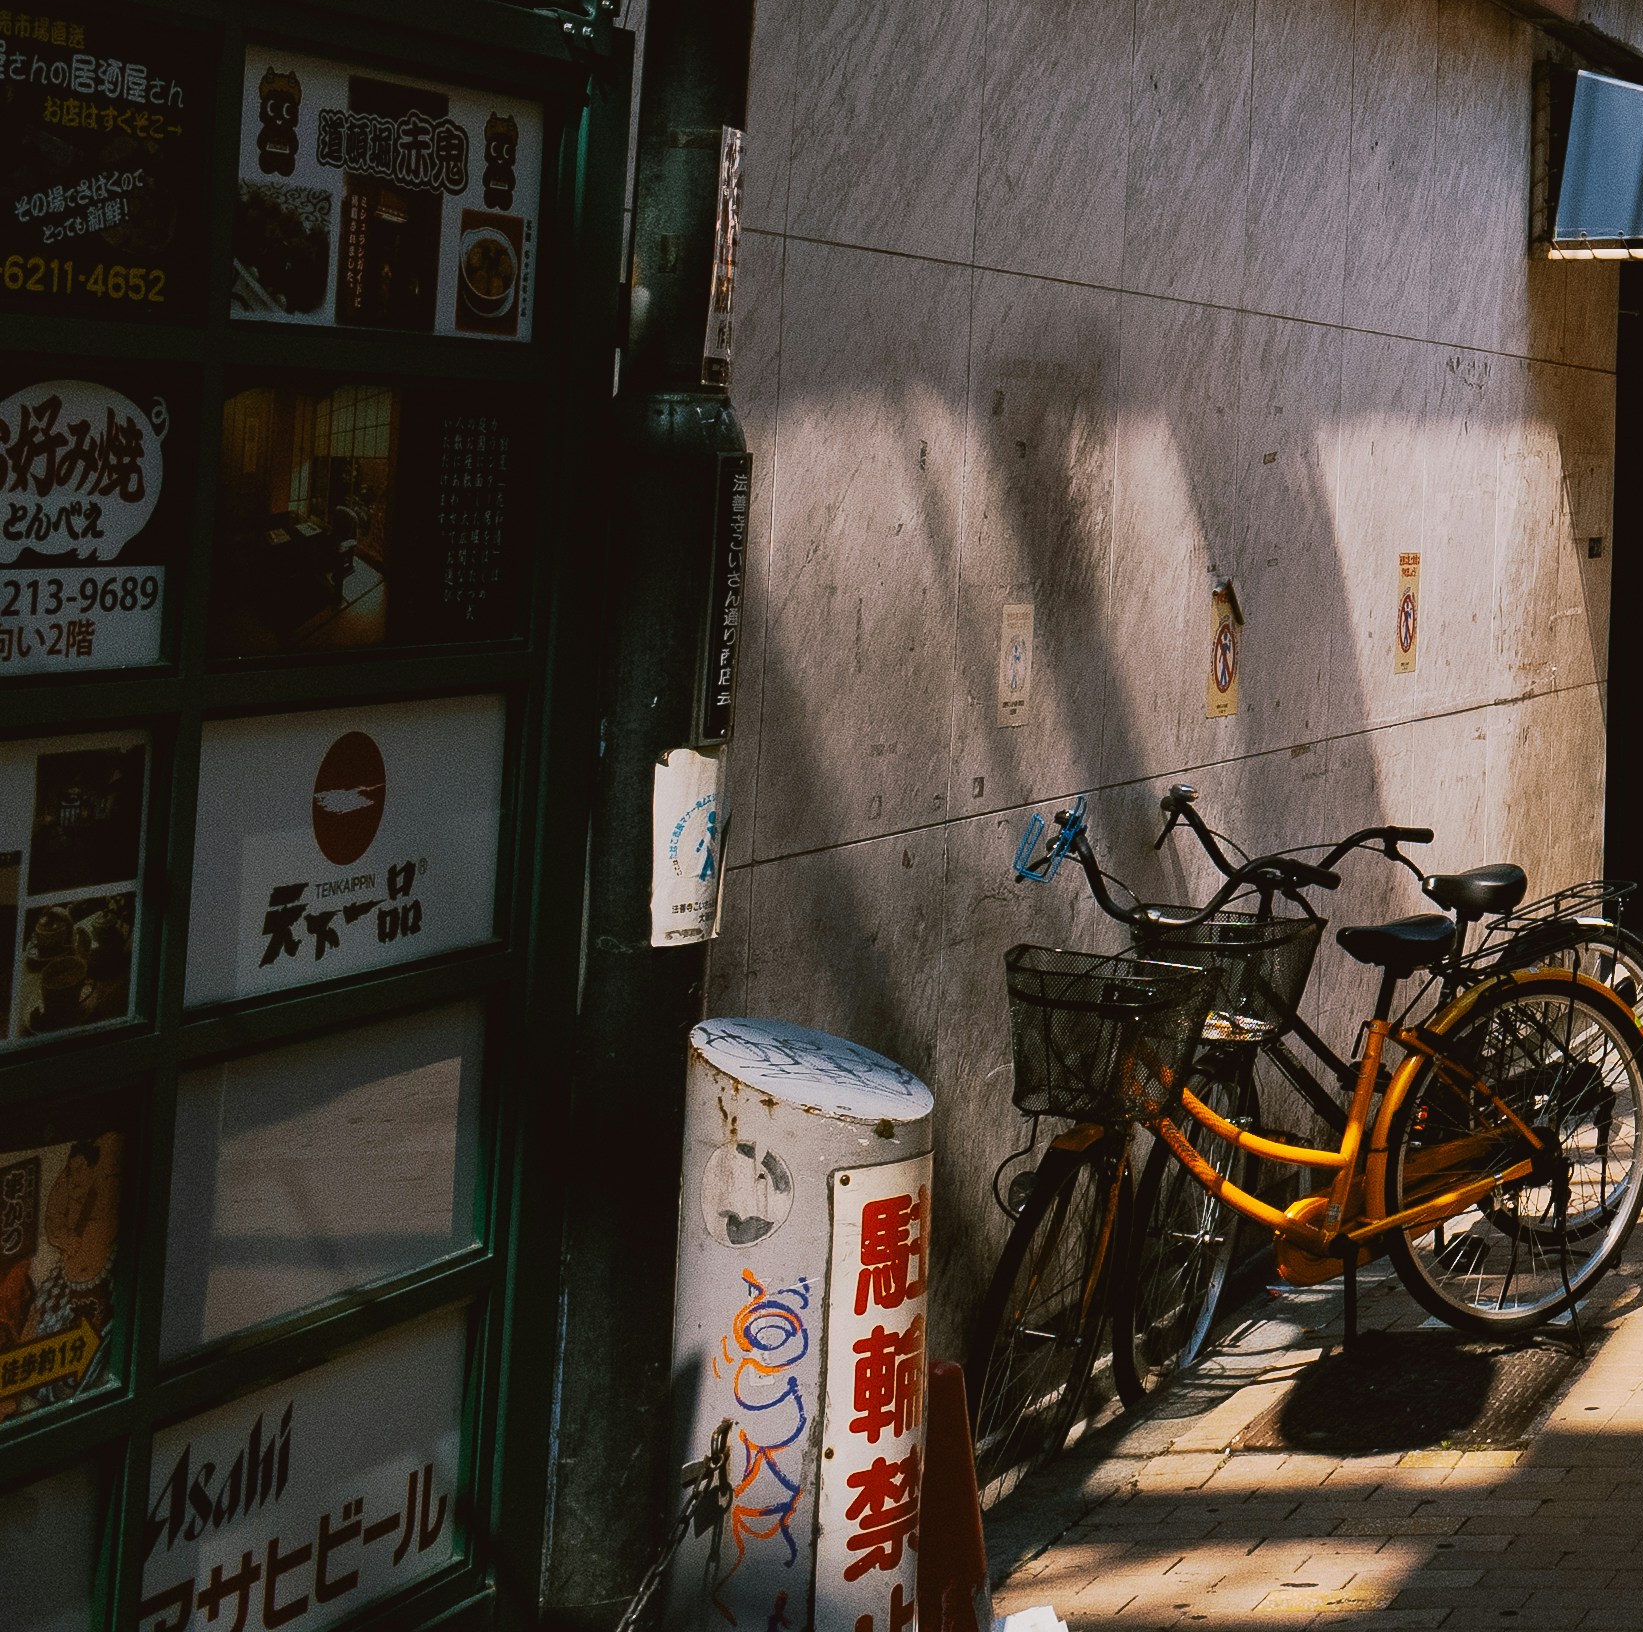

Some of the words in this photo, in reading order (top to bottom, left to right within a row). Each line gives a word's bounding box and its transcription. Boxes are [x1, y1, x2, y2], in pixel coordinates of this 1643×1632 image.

[0, 39, 185, 109] さんの居酒屋さん
[42, 95, 165, 139] お店はすぐそこ
[318, 109, 468, 196] 道頓堀赤鬼
[3, 501, 105, 542] とんべえ
[258, 860, 422, 968] 天下一品
[315, 874, 376, 900] TENKAIPPIN
[141, 1399, 294, 1566] Asahi
[138, 1462, 448, 1632] アサヒビール
